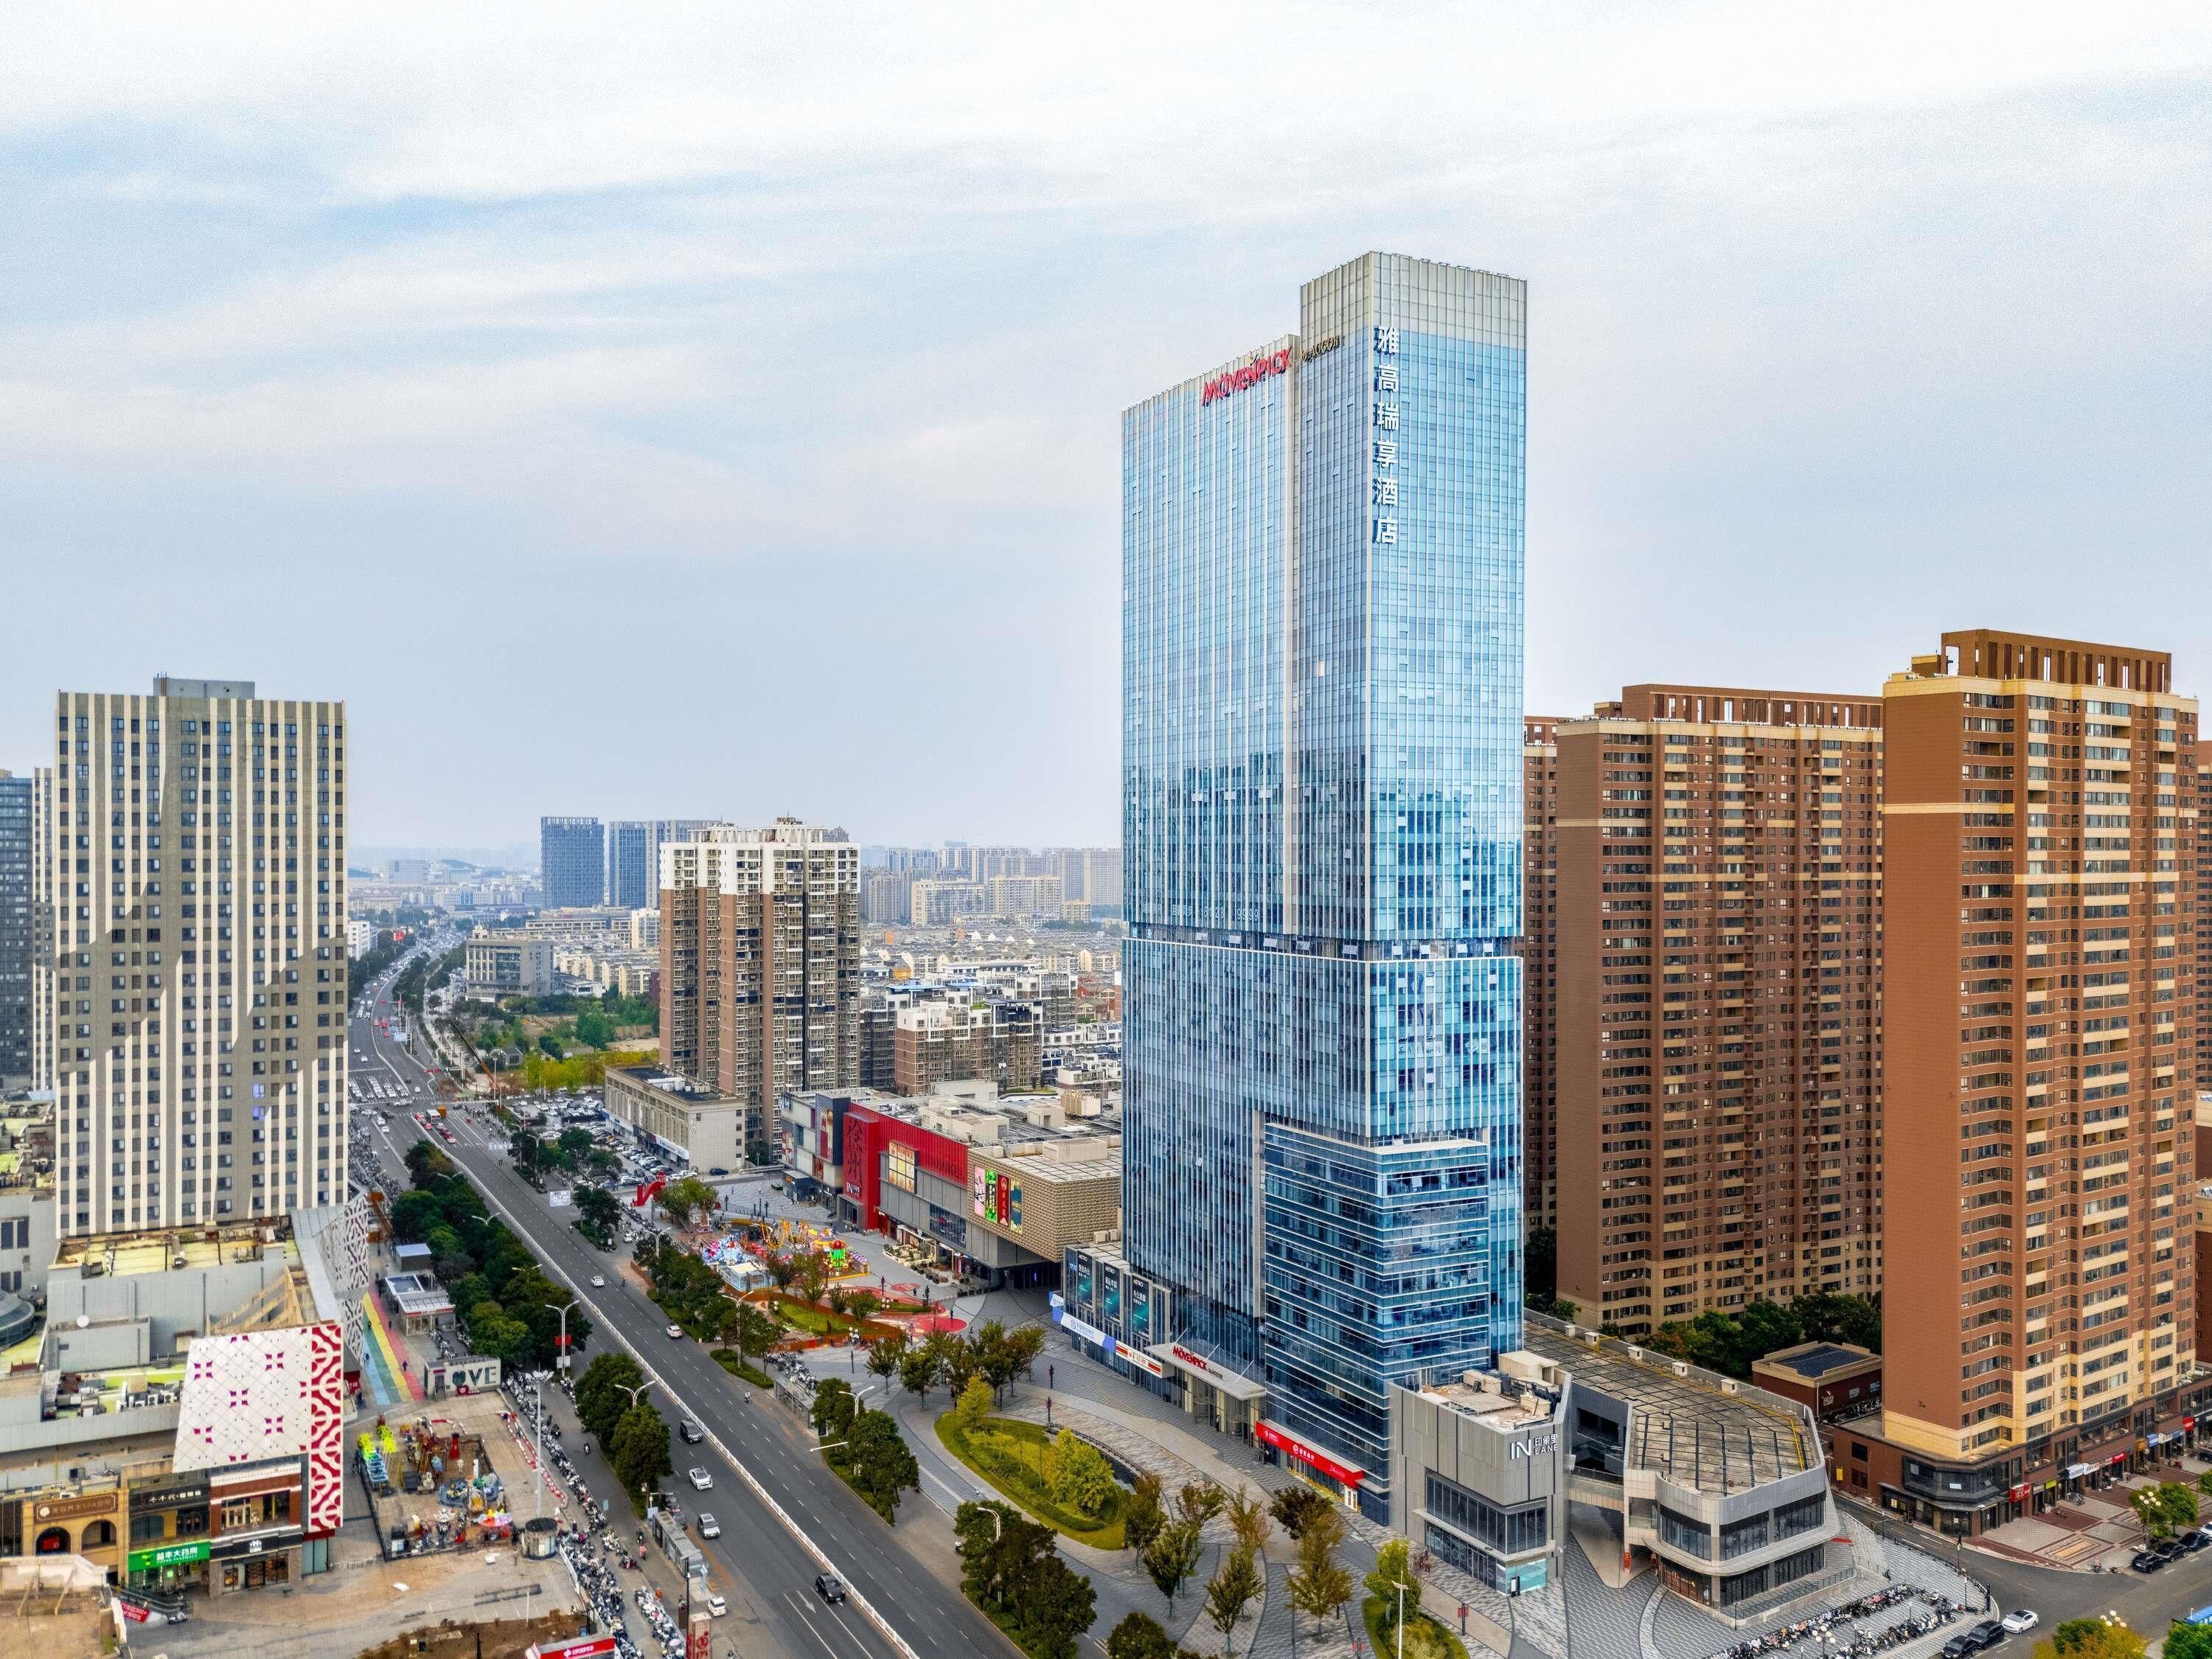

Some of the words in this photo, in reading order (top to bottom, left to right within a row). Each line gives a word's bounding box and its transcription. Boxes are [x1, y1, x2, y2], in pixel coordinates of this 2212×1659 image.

[1201, 346, 1293, 406] MÖVENPICK
[1375, 325, 1399, 544] 雅高瑞享酒店
[1172, 1345, 1208, 1371] MÖVENPICK
[1511, 1439, 1531, 1460] IN
[1534, 1433, 1558, 1447] 印象里
[1534, 1444, 1558, 1455] LANE
